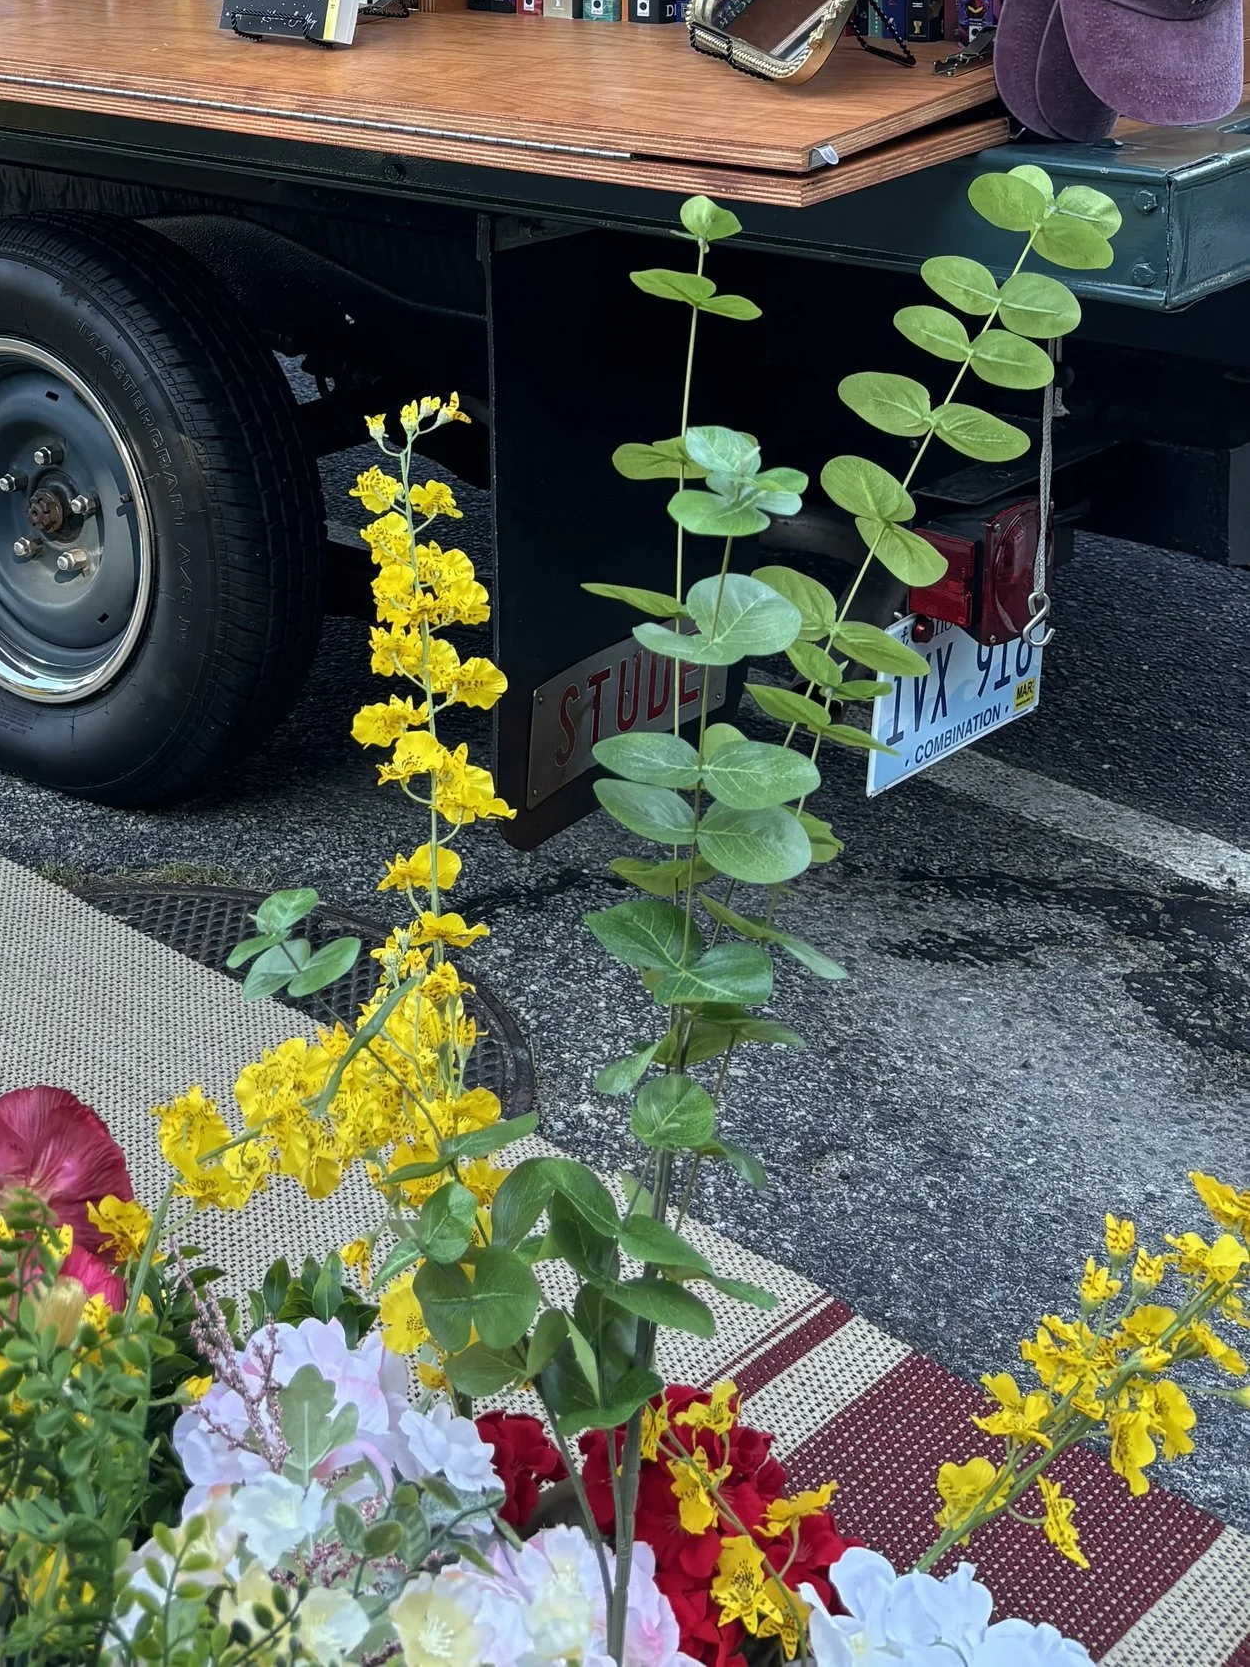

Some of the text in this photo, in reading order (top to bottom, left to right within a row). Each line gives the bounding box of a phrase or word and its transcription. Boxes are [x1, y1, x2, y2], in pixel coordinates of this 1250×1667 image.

[555, 650, 700, 767] STUDE
[1017, 682, 1033, 699] MAR
[915, 702, 1001, 764] COMBINATION
